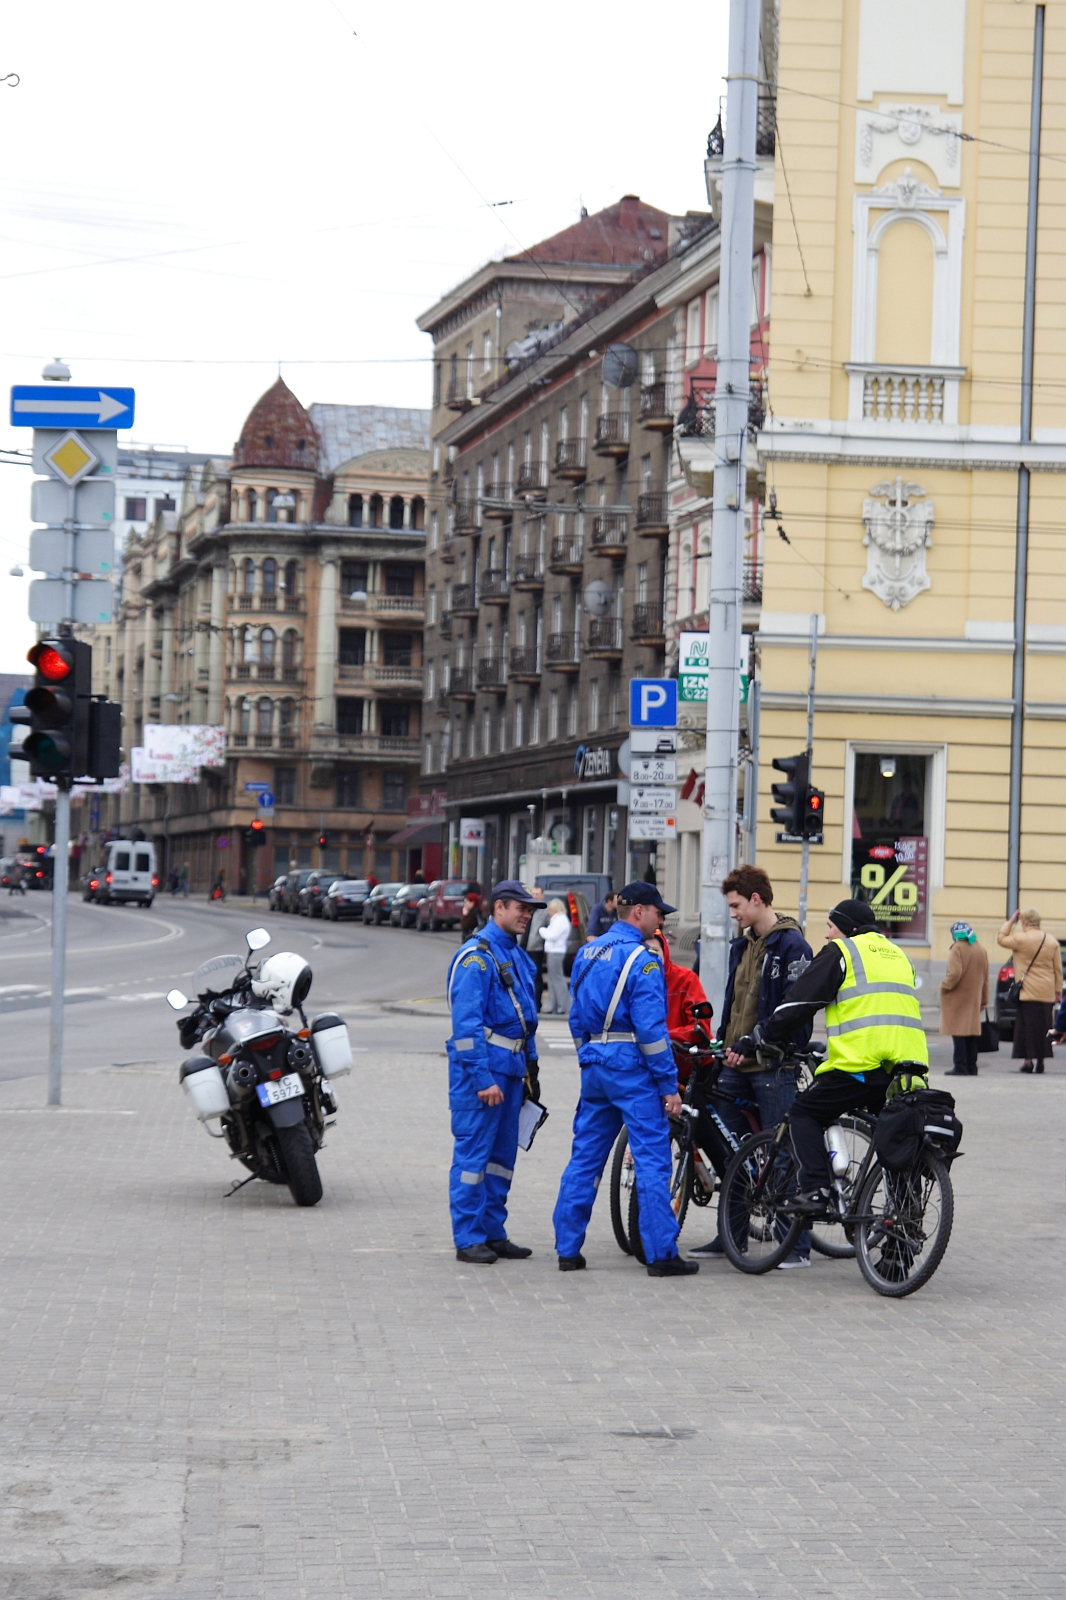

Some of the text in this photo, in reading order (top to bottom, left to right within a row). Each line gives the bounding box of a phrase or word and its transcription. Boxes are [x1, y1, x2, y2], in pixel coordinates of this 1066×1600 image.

[641, 685, 667, 721] P
[584, 747, 610, 777] ŽENĒVA
[633, 771, 674, 780] 8.00-20.00
[633, 799, 673, 808] 9.00-17.00
[272, 1085, 300, 1101] 5972
